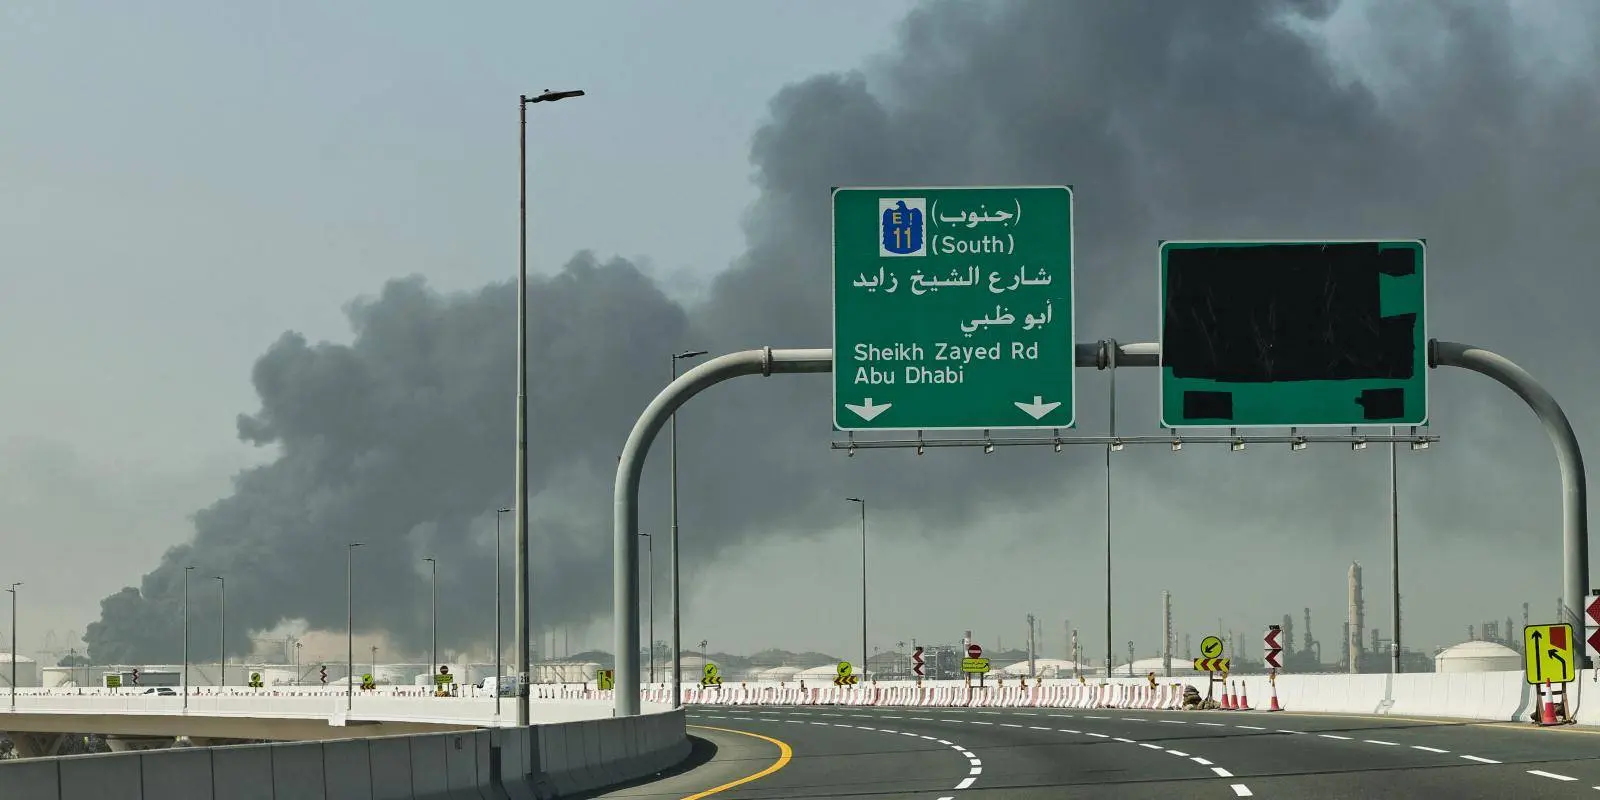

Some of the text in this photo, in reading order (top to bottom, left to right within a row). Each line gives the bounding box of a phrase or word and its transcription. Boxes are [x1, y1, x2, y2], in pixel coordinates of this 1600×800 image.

[892, 212, 902, 225] E
[931, 198, 1021, 229] (جنوب)
[893, 227, 911, 249] 11
[932, 234, 1014, 255] (South)
[853, 265, 1052, 296] شارع الشيخ زايد
[960, 299, 1053, 338] أبو ظبي
[854, 341, 1039, 364] Sheikh Zayed Rd
[854, 366, 964, 385] Abu Dhabi
